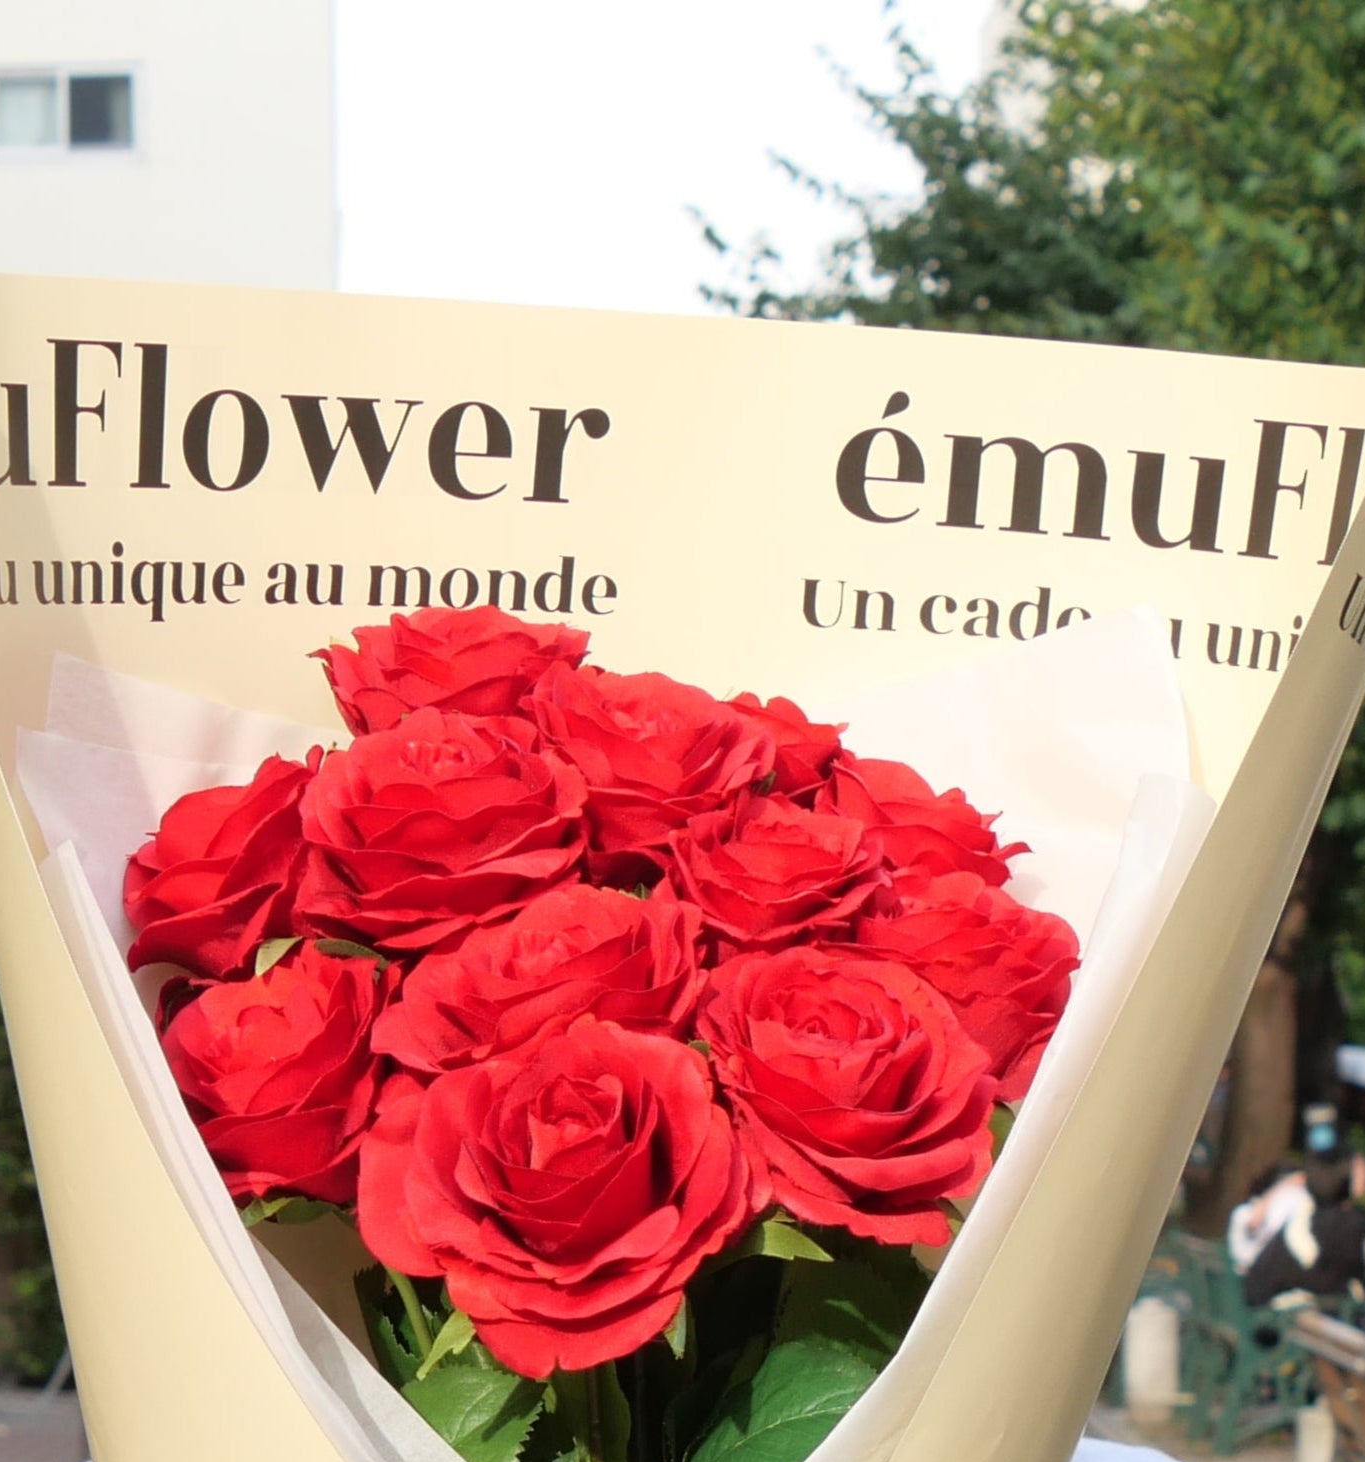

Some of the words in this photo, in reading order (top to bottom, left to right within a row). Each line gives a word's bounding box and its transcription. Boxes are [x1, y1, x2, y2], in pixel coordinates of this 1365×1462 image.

[31, 540, 247, 623] unique
[263, 560, 345, 606] au
[366, 554, 619, 616] monde
[800, 577, 898, 632] Un
